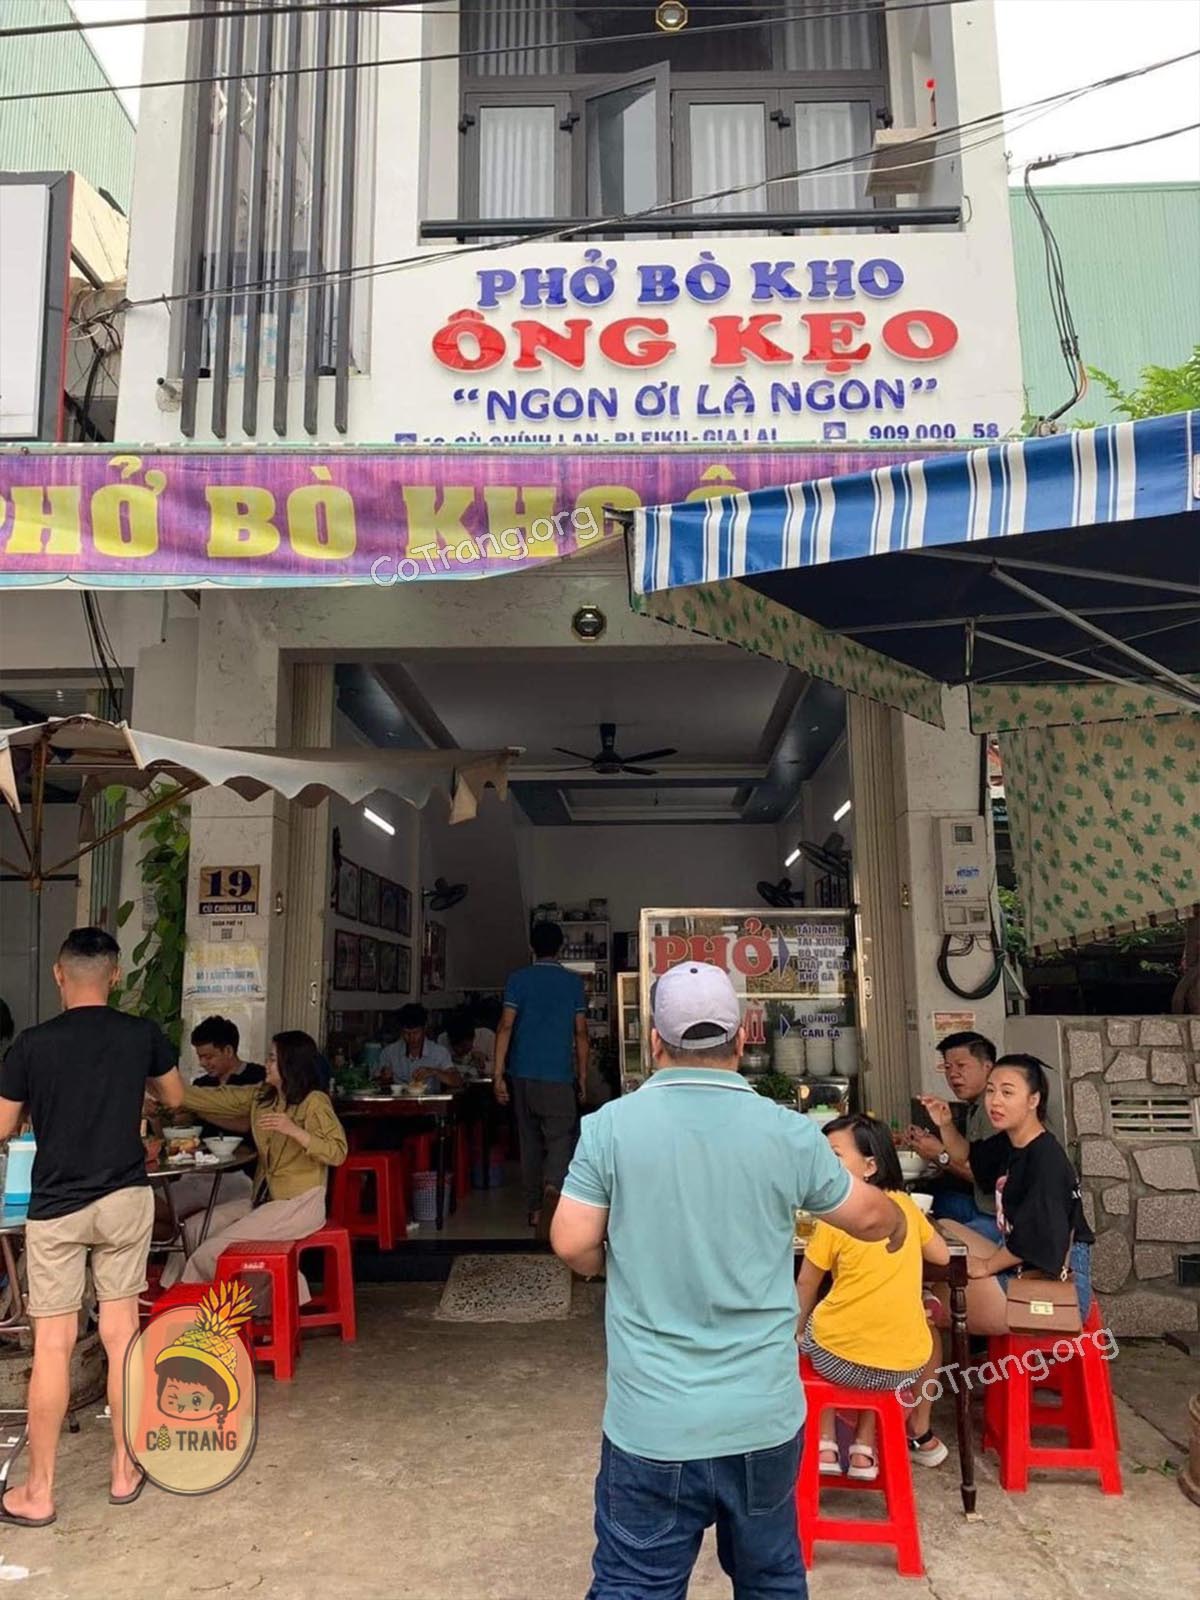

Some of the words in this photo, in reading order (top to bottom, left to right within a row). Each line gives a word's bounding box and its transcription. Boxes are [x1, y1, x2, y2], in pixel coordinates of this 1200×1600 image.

[477, 249, 618, 309] PHỞ
[637, 250, 731, 306] BÒ
[750, 258, 905, 303] KHO
[432, 308, 677, 372] ÔNG
[708, 309, 959, 375] KẸO
[634, 381, 681, 418] ƠI
[696, 375, 756, 417] LÀ
[869, 424, 910, 440] 909
[915, 423, 956, 439] 000
[973, 422, 1000, 439] 58
[0, 455, 167, 557] HỞ
[206, 466, 356, 559] BÒ
[207, 870, 252, 898] 19
[651, 917, 773, 977] PHỞ
[801, 1028, 825, 1038] CARI
